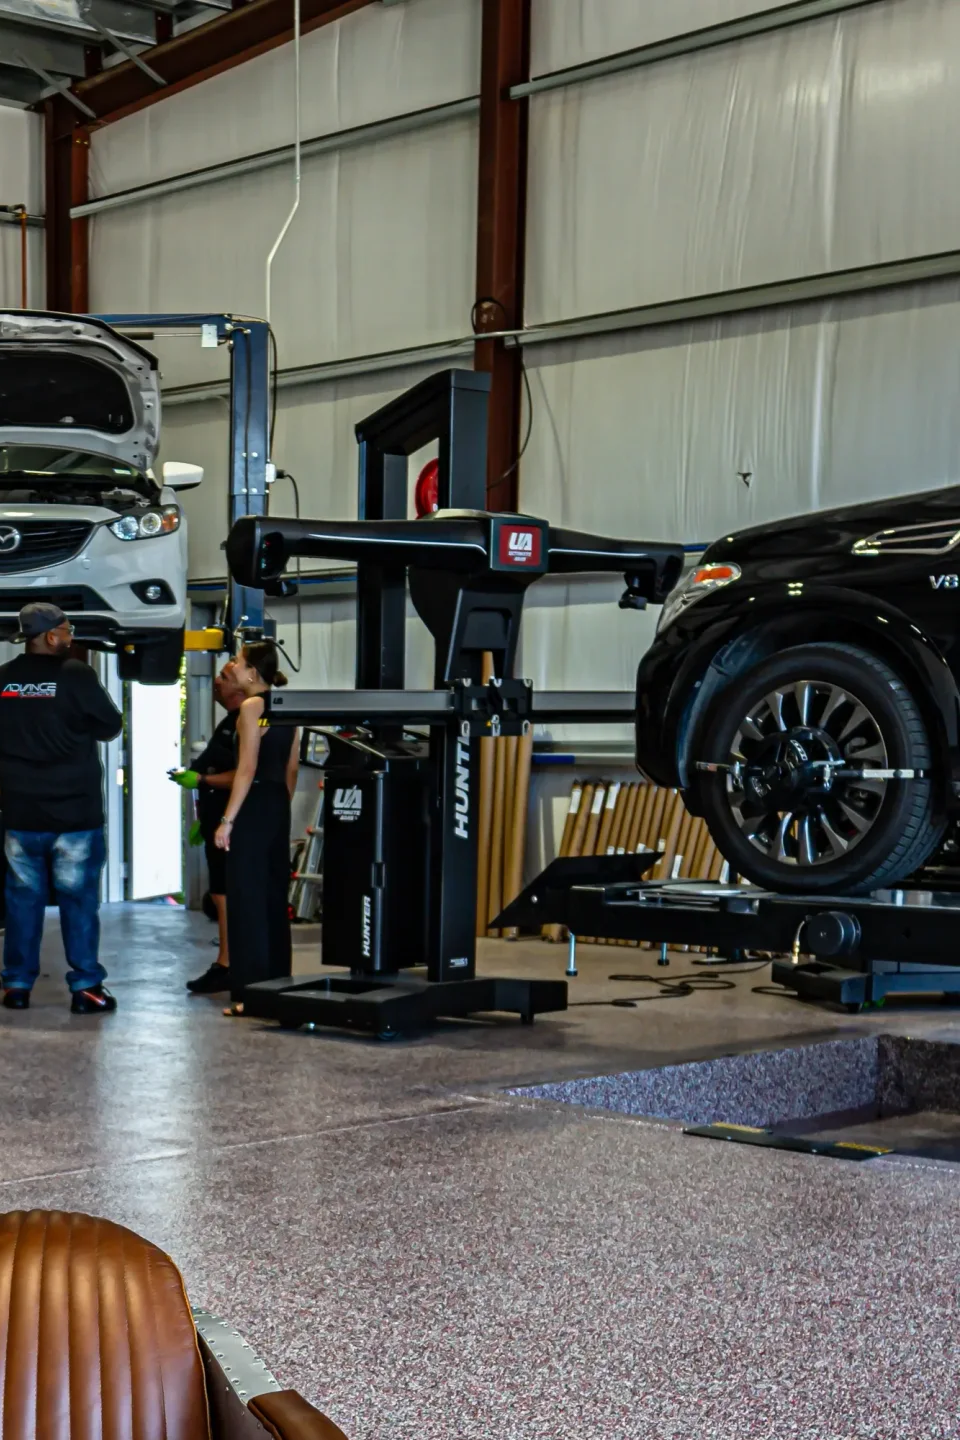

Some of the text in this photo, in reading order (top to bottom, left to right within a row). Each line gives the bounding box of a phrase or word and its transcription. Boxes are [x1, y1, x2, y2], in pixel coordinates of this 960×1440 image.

[929, 574, 959, 589] V8
[3, 682, 57, 693] ADVANCE
[454, 735, 470, 839] HUNT
[362, 894, 372, 958] HUNTER
